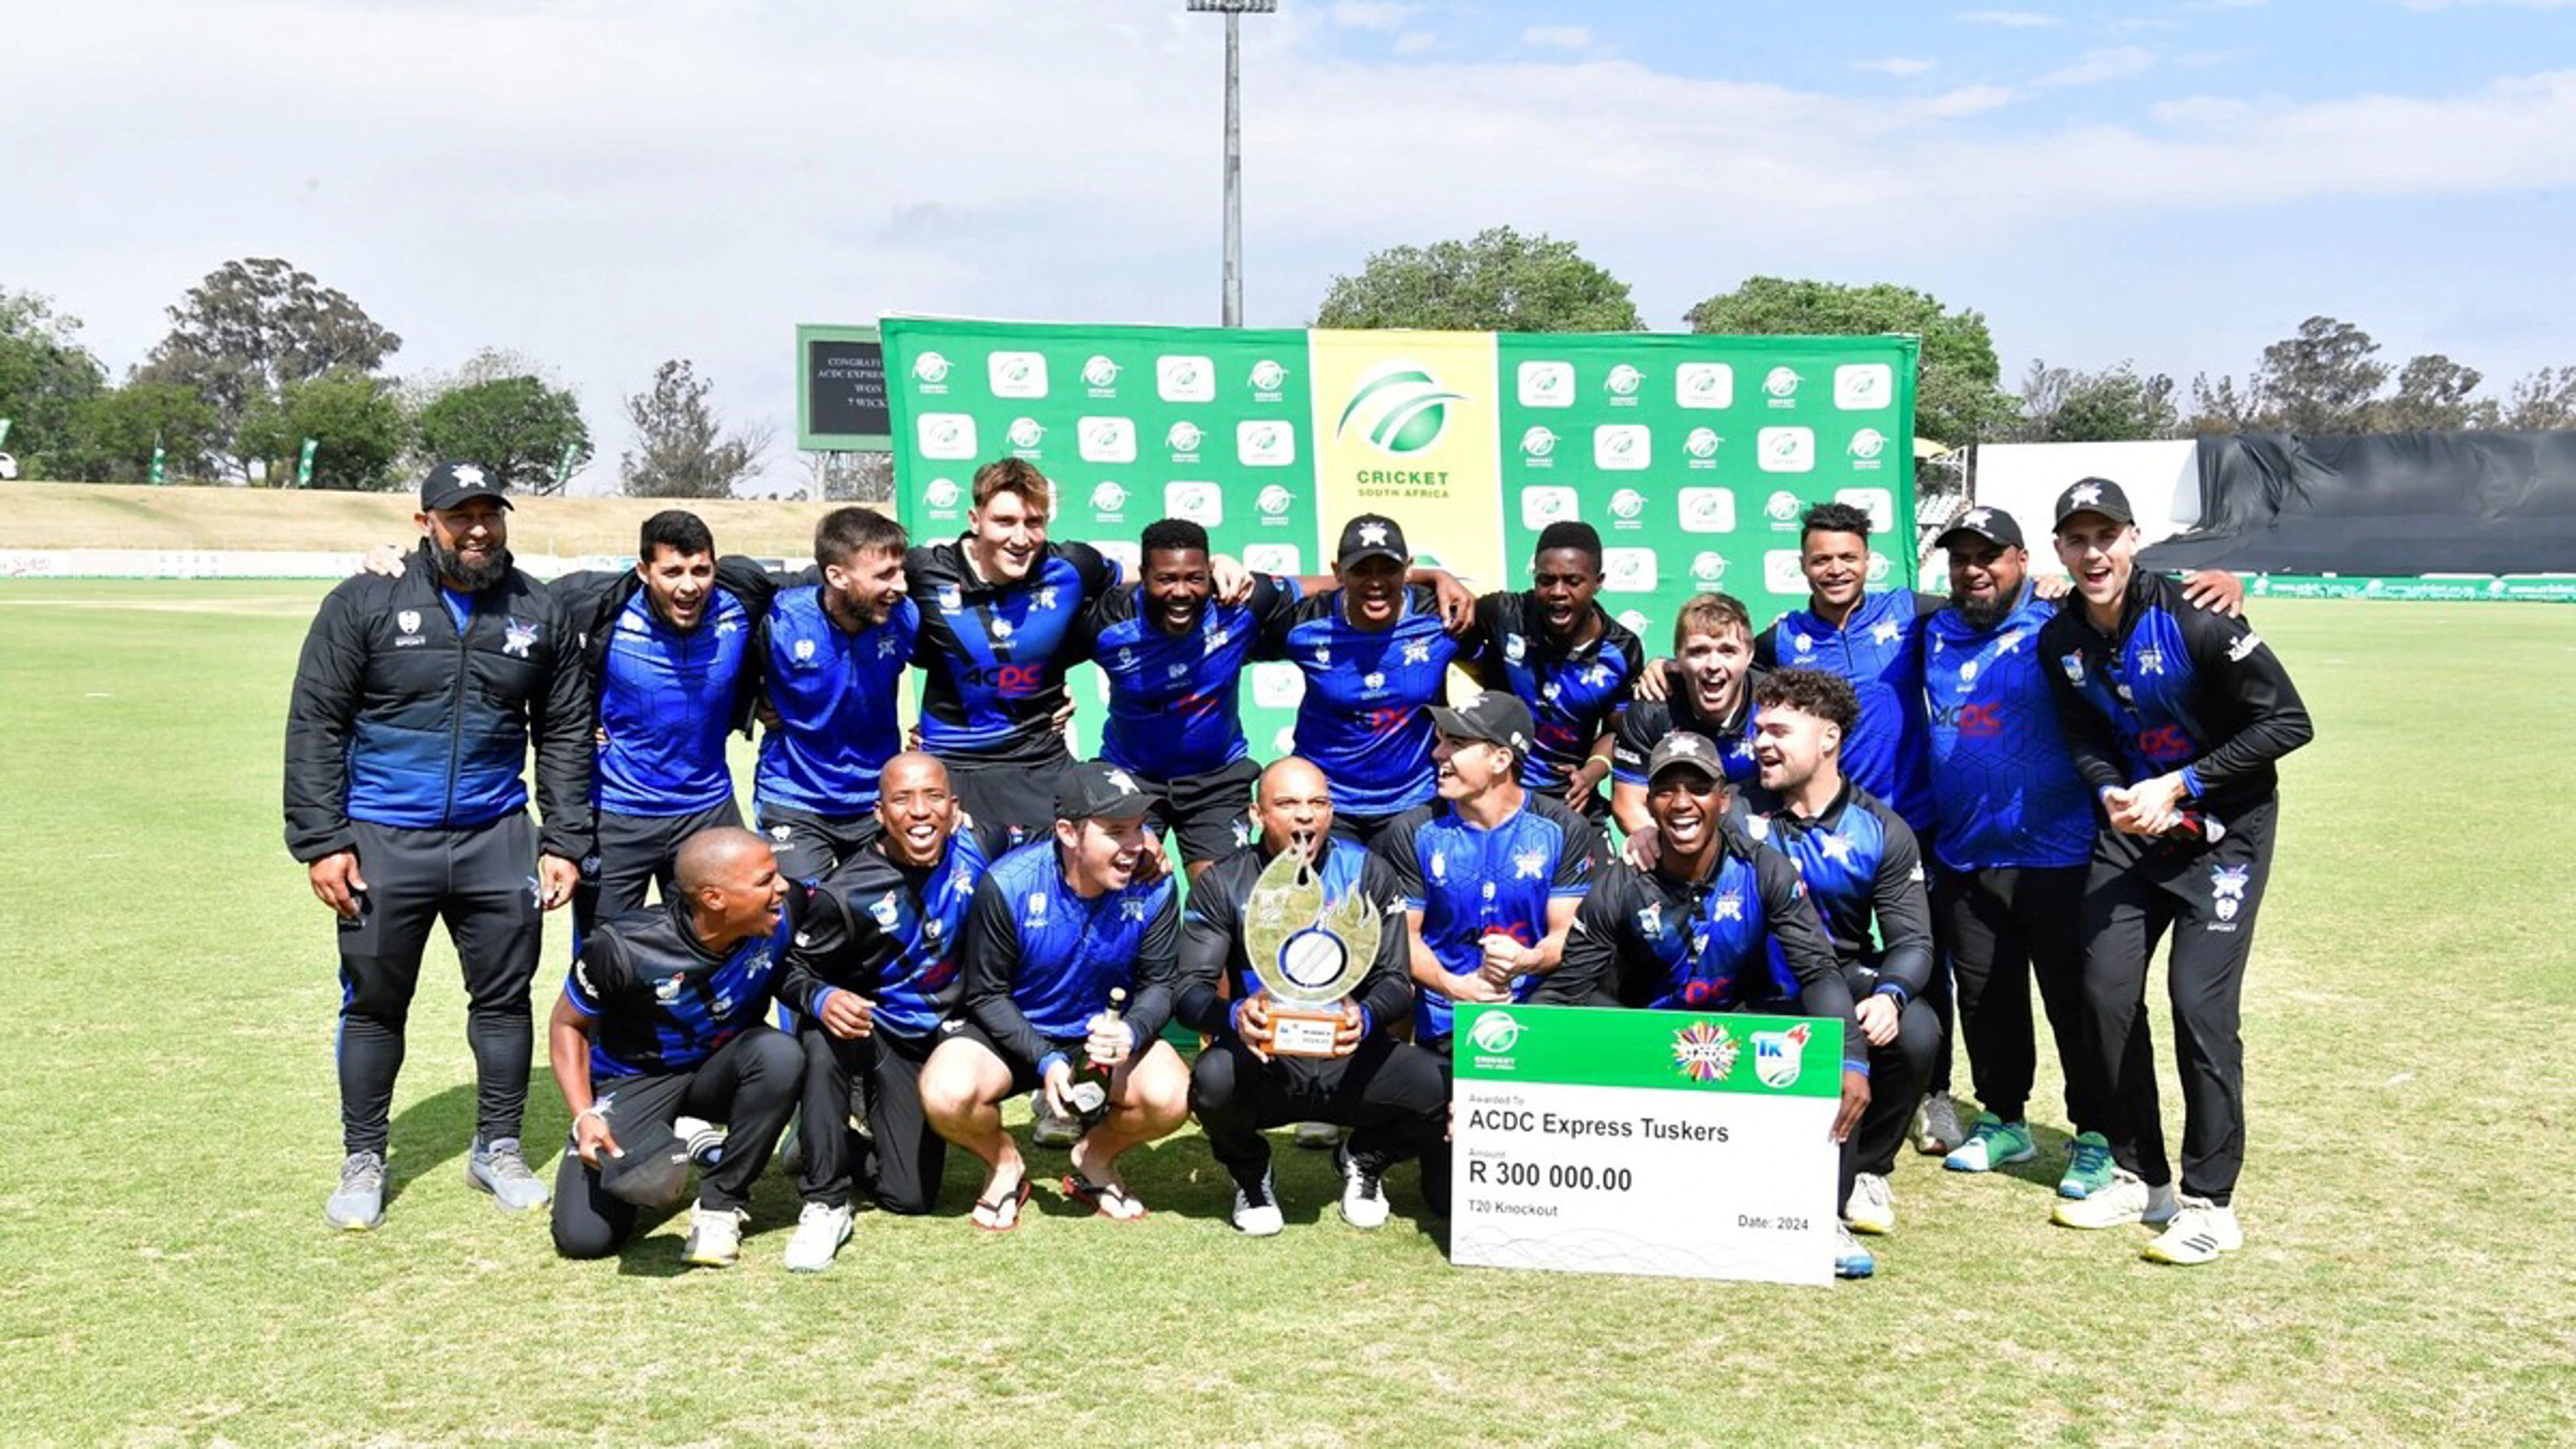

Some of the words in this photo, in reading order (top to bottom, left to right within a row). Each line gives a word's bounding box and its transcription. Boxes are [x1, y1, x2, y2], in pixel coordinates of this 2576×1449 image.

[855, 384, 883, 393] WON
[1356, 470, 1449, 485] CRICKET
[1358, 488, 1400, 497] SOUTH
[1405, 488, 1450, 498] AFRICA
[1468, 1094, 1510, 1105] Awarded
[1513, 1095, 1525, 1106] To
[1468, 1109, 1534, 1132] ACDC
[1543, 1113, 1633, 1139] Express
[1640, 1118, 1729, 1142] Tuskers
[1468, 1148, 1506, 1158] Amount
[1470, 1160, 1487, 1183] R
[1496, 1161, 1540, 1186] 300
[1549, 1165, 1632, 1191] 000.00
[1468, 1199, 1492, 1213] T20
[1495, 1201, 1558, 1217] Knockout
[1738, 1214, 1772, 1228] Date:
[1777, 1216, 1809, 1230] 2024
